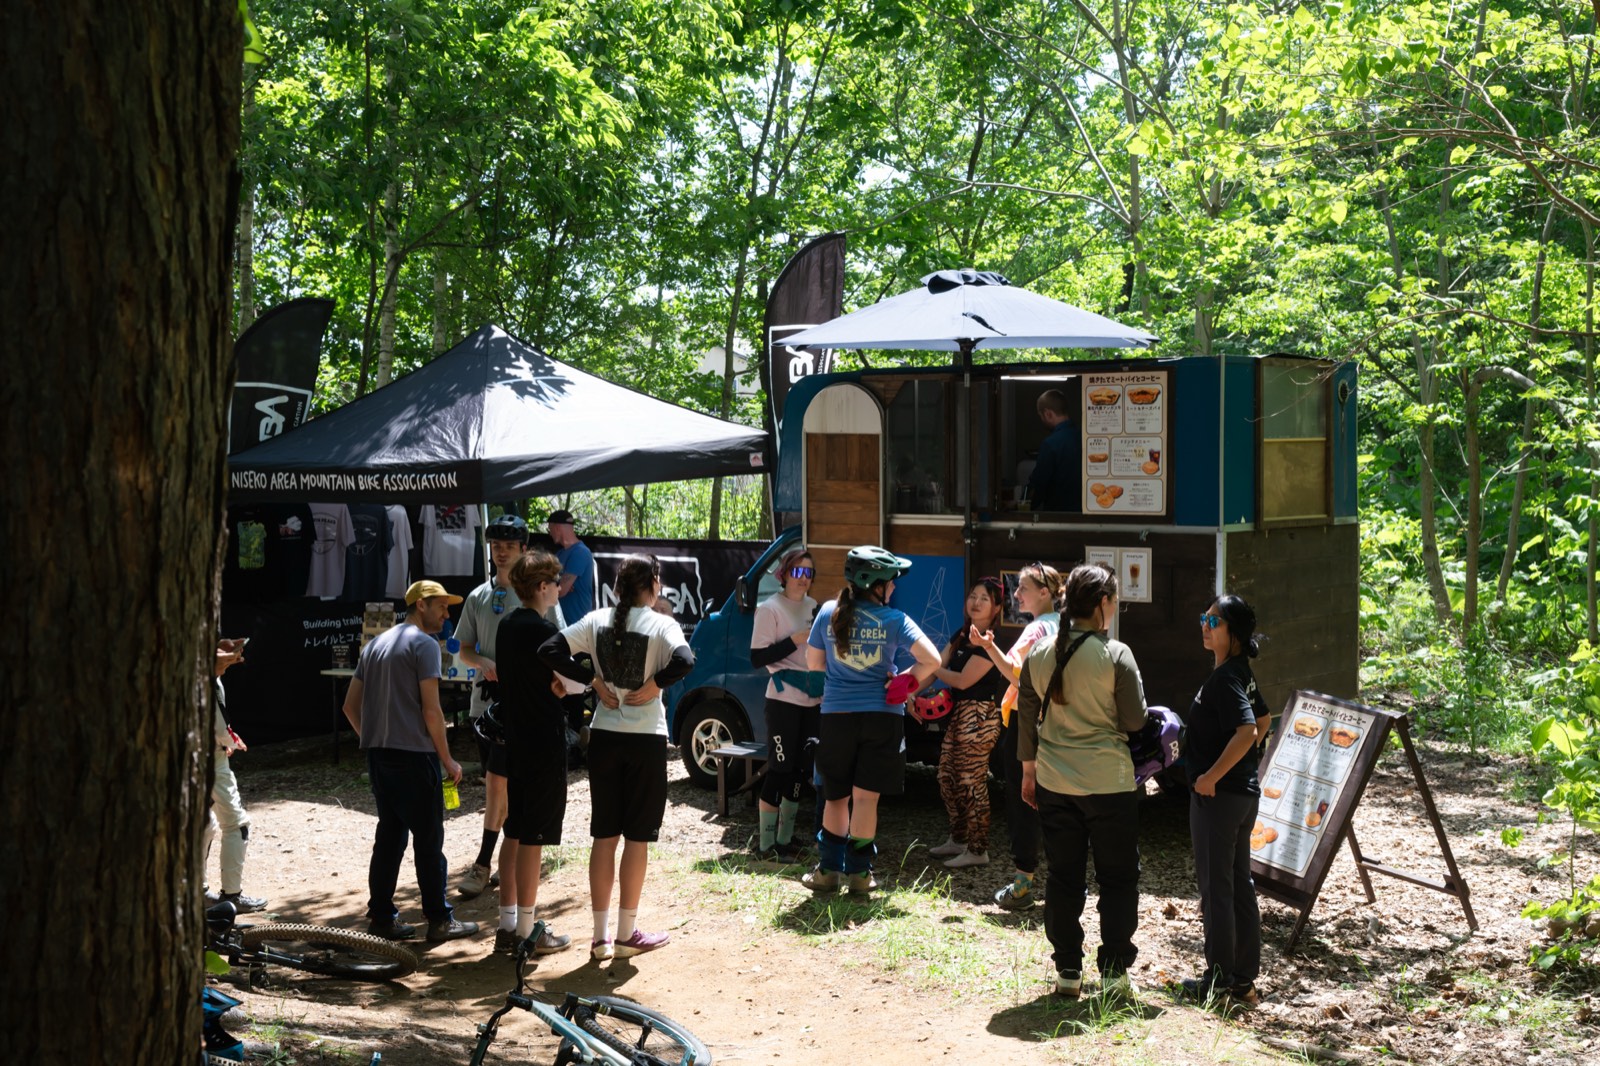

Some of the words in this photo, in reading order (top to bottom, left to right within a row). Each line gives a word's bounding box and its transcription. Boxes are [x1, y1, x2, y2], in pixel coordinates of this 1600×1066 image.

[232, 471, 267, 489] NISEKO
[270, 472, 297, 490] AREA
[301, 473, 355, 491] MOUNTAIN
[358, 474, 381, 490] BIKE
[383, 472, 458, 491] ASSOCIATION
[303, 620, 342, 630] Building
[343, 616, 363, 626] trails
[860, 628, 887, 639] CREW
